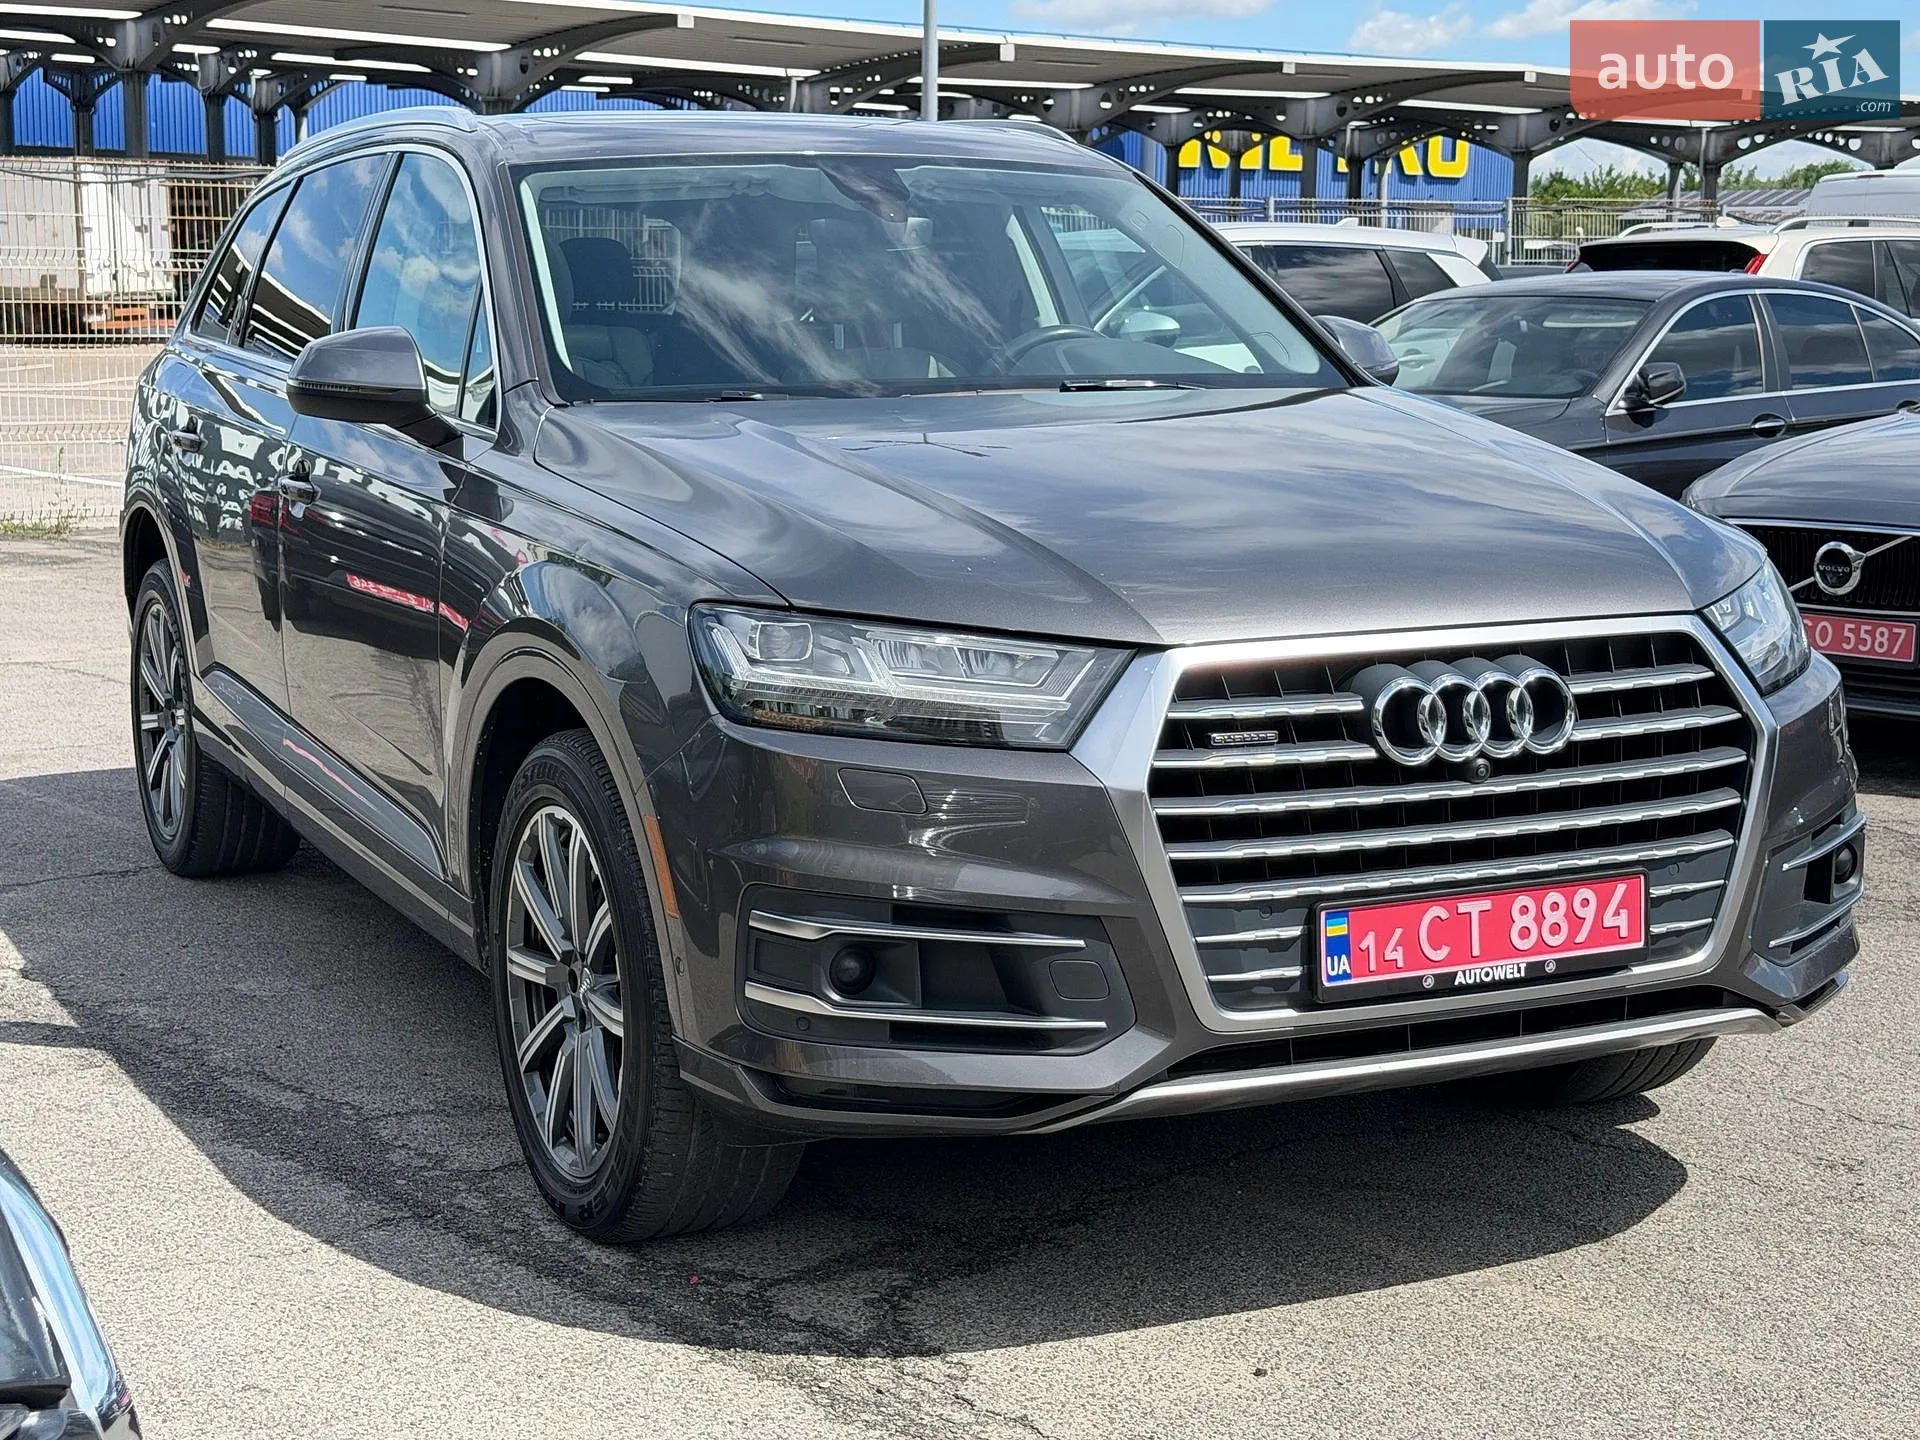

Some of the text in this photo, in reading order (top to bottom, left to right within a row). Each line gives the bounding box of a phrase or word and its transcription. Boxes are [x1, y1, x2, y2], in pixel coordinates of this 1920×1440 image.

[1818, 564, 1850, 573] VOLVO
[1803, 619, 1907, 655] O 5587
[1358, 883, 1629, 972] 14 CT 8894
[1326, 954, 1351, 976] UA
[1454, 963, 1527, 986] AUTOWELT
